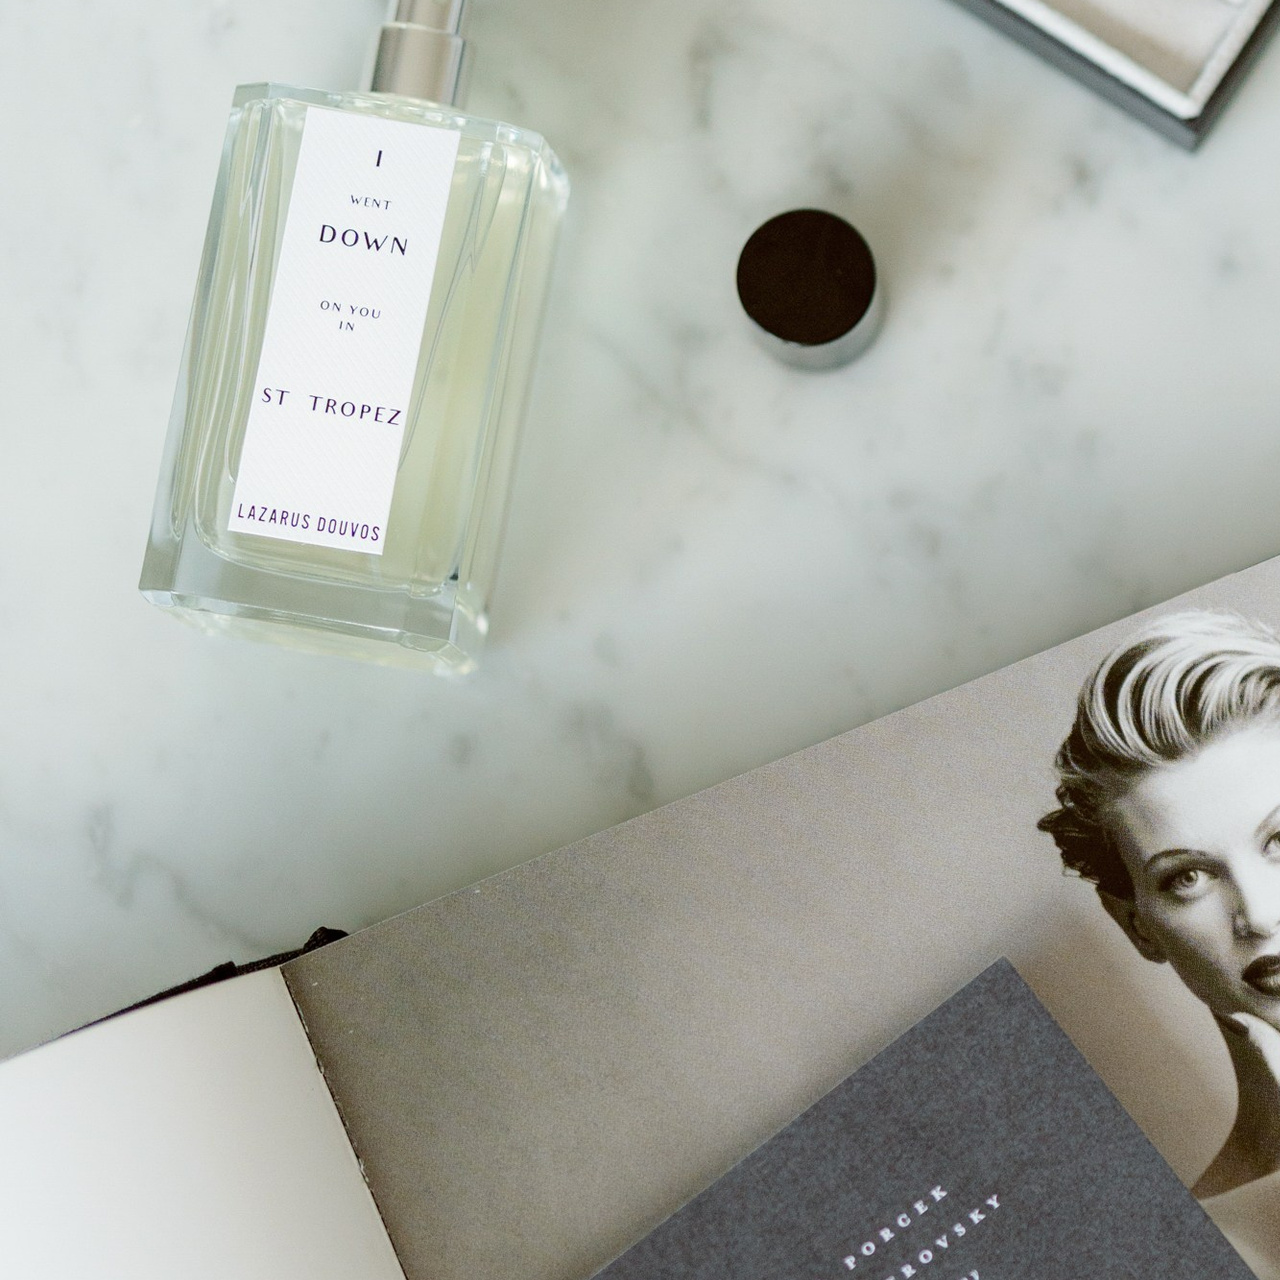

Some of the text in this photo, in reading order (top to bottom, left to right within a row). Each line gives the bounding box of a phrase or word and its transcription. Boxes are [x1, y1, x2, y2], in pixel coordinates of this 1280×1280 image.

[374, 149, 383, 168] I
[350, 194, 392, 211] WENT
[319, 224, 408, 256] DOWN
[320, 300, 382, 320] ON YOU
[339, 320, 355, 332] IN
[261, 387, 402, 426] ST TROPEZ
[237, 503, 381, 543] LAZARUS DOUVOS
[844, 1185, 948, 1270] PORCEK
